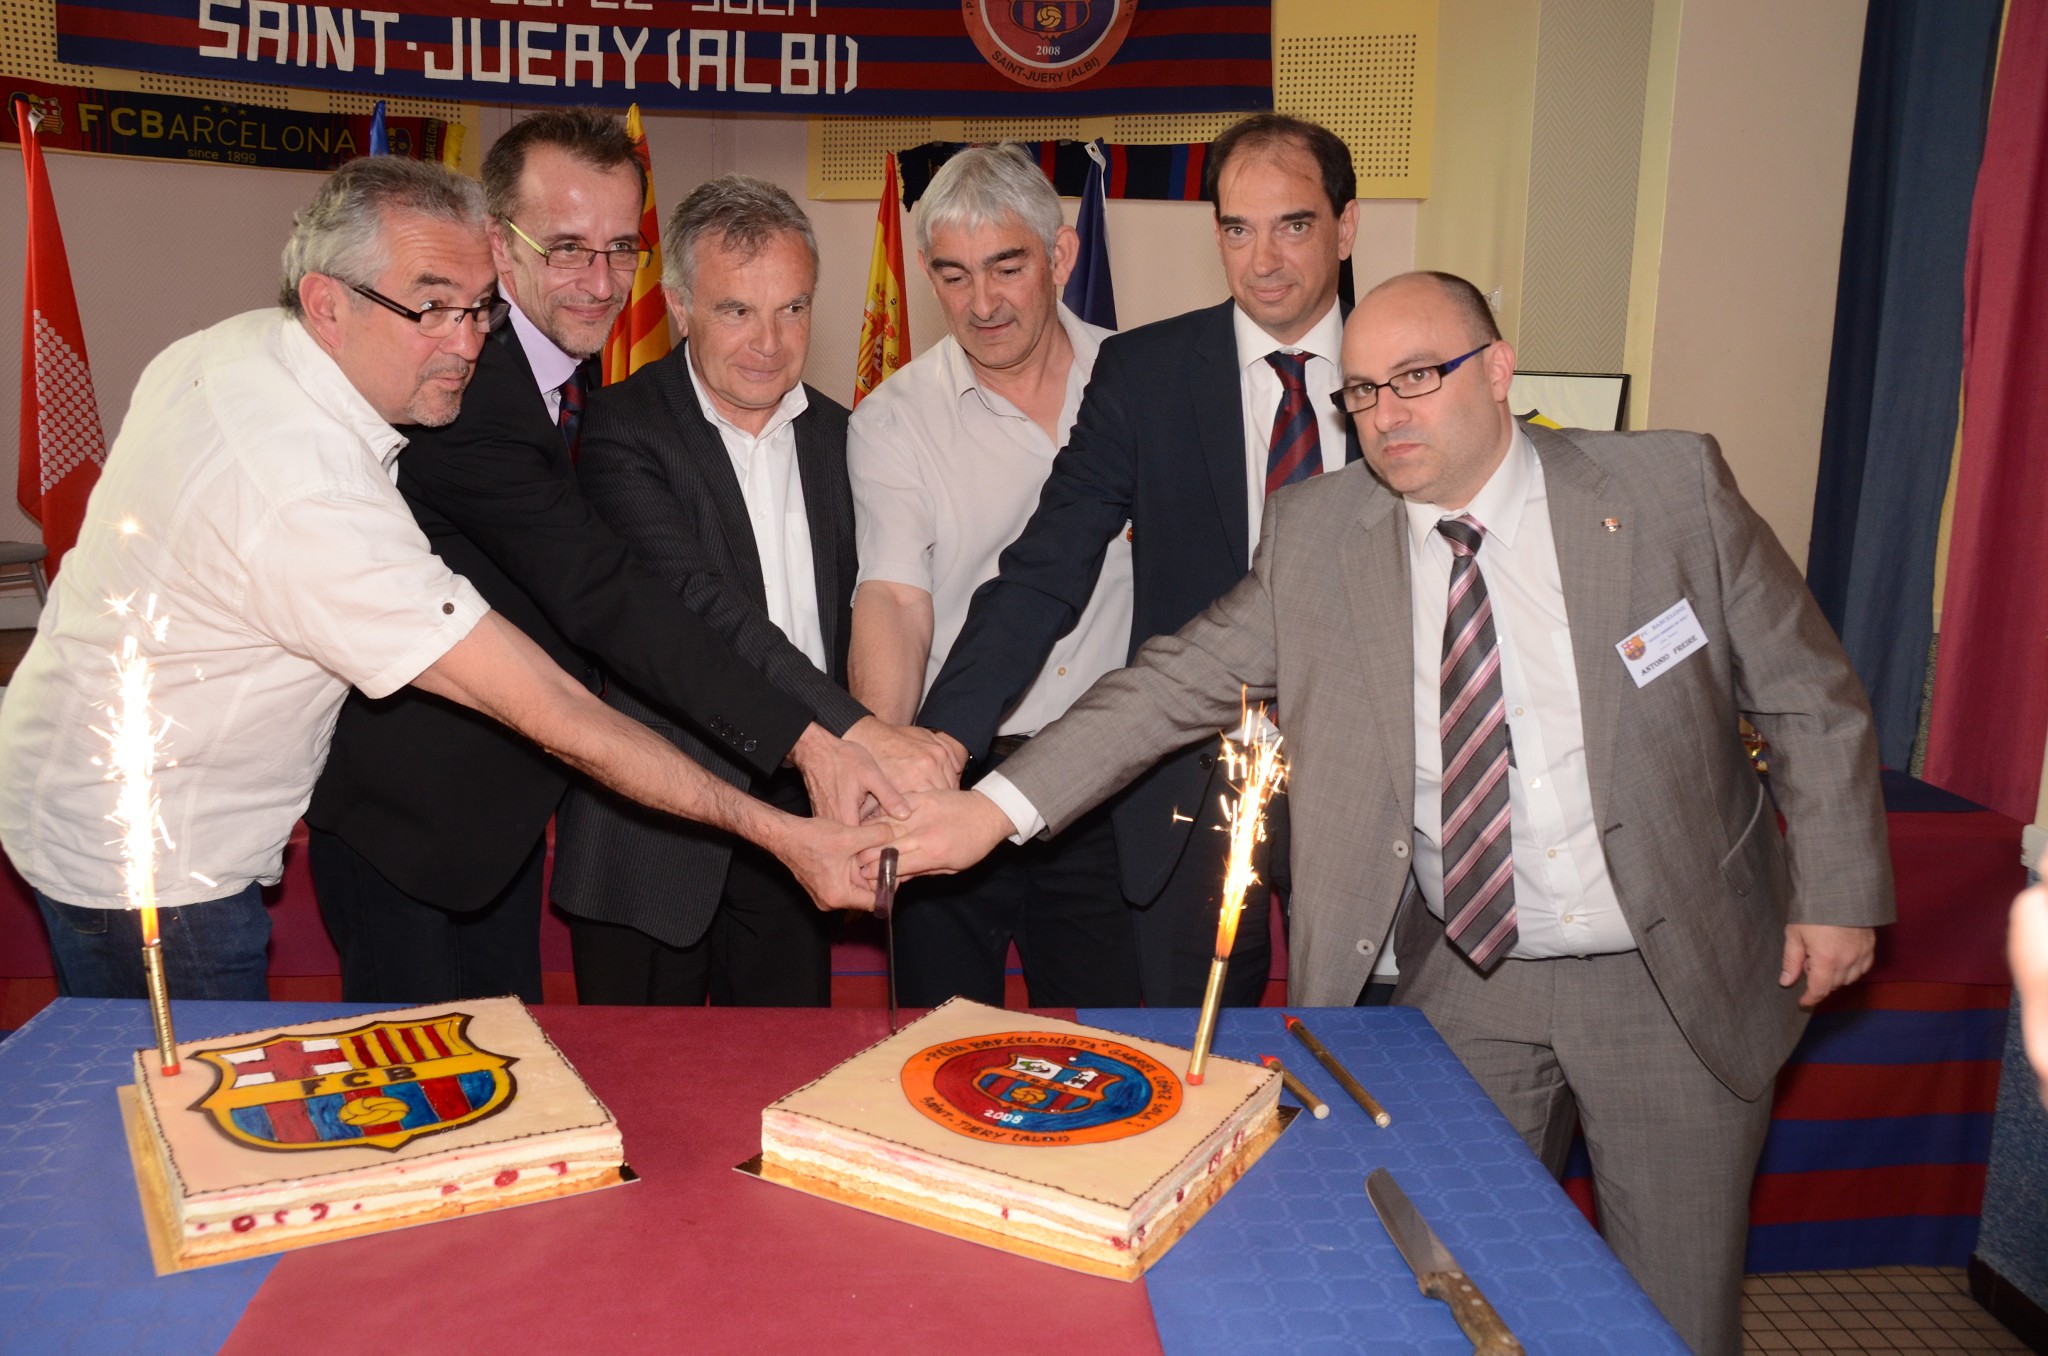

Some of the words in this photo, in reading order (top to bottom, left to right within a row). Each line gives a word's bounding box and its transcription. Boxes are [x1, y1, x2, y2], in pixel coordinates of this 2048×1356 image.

[667, 28, 858, 95] (ALBI)
[1036, 45, 1061, 56] 2008
[991, 51, 1063, 83] SAINT-JUERY
[1067, 57, 1100, 82] (ALBI)
[187, 147, 219, 161] since
[226, 151, 257, 165] 1899
[1641, 653, 1670, 676] ANTONIO
[1672, 634, 1698, 655] FREIRE
[300, 1066, 417, 1096] FCB
[983, 1109, 1024, 1124] 2008
